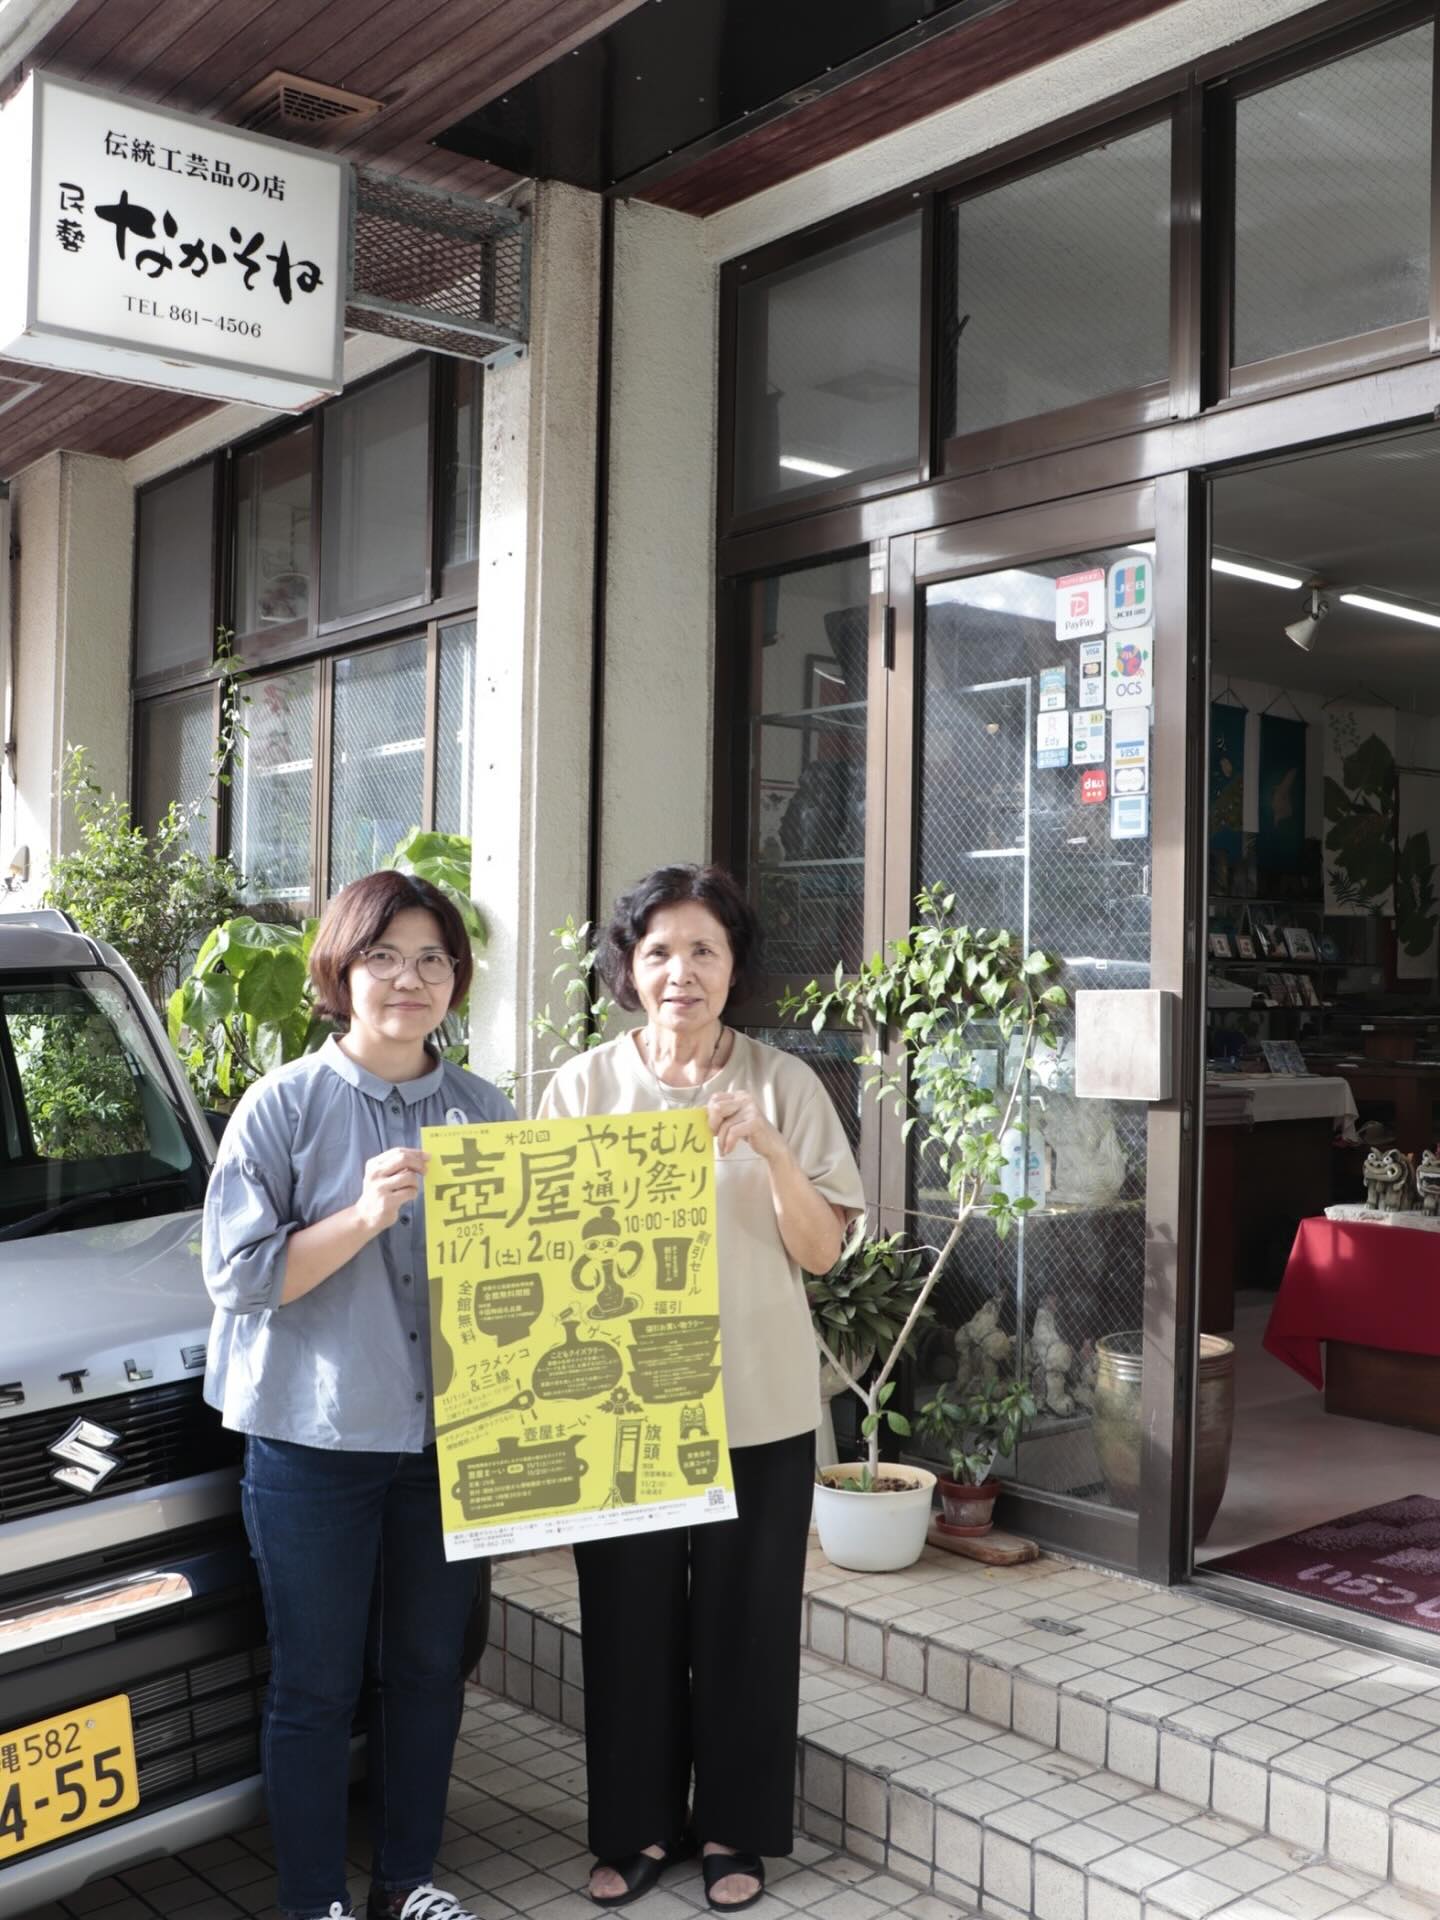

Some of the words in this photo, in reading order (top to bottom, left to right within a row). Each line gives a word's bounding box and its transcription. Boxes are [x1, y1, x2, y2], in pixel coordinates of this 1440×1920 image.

[104, 130, 286, 201] 伝統工芸品の店
[94, 190, 324, 304] なかそね
[123, 295, 164, 318] TEL
[169, 304, 262, 338] 861-4506
[1065, 619, 1095, 631] PayPay
[1086, 648, 1100, 656] VISA
[1116, 681, 1143, 697] OCS
[1119, 748, 1140, 758] VISA
[578, 1121, 706, 1168] やちむん
[435, 1137, 580, 1228] 壺屋
[582, 1160, 708, 1209] 通り祭り
[457, 1224, 484, 1238] 2025
[625, 1207, 707, 1233] 10:00-18:00
[457, 1280, 476, 1345] 全館無料
[653, 1300, 682, 1315] 福引
[587, 1326, 621, 1347] ゲーム
[466, 1348, 531, 1377] フラメンコ
[643, 1423, 662, 1462] 旗頭
